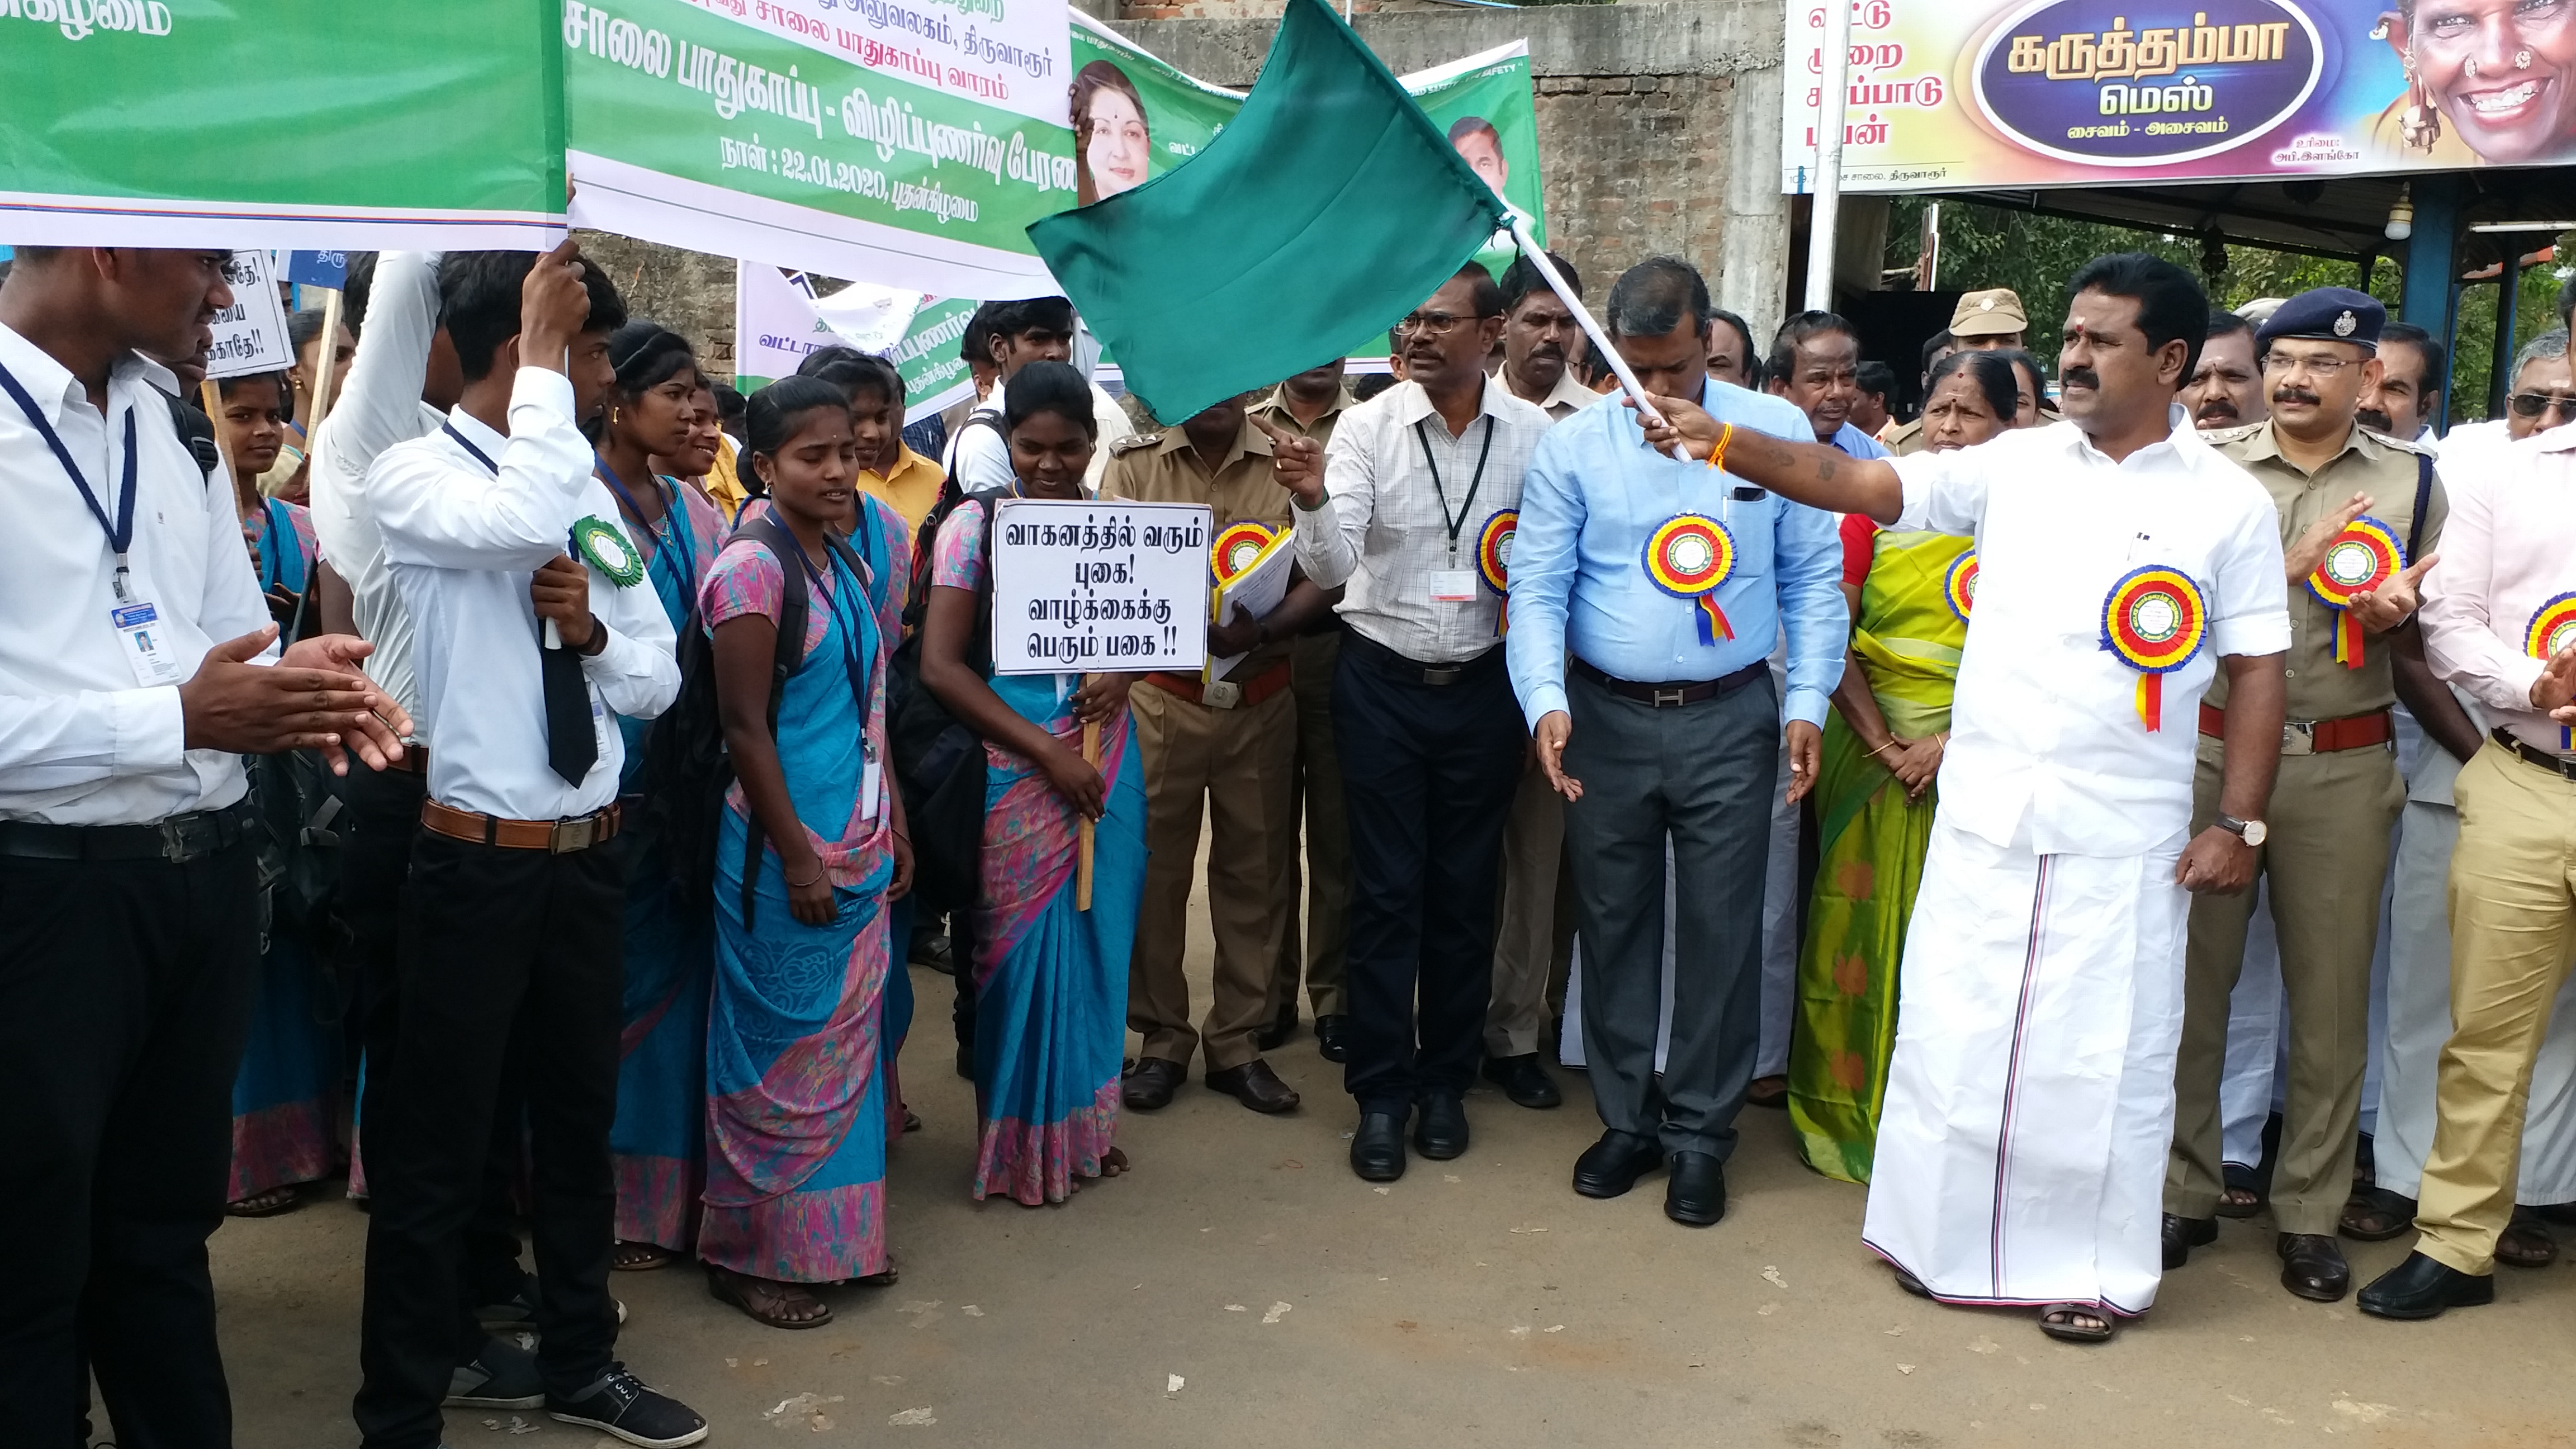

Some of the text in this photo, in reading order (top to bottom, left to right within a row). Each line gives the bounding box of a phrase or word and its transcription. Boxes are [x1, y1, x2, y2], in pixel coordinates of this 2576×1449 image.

[756, 0, 1008, 100] சாலை பாதுகாப்பு வாரம்
[964, 25, 1052, 78] திருவாரூர்
[2007, 12, 2289, 83] கருத்தம்மா
[1481, 63, 1516, 77] SAFETY
[564, 0, 671, 78] சாலை
[678, 40, 823, 139] பாதுகாப்பு
[842, 87, 1005, 185] விழிப்புணர்வு
[2099, 76, 2213, 116] மெஸ்
[2067, 120, 2130, 139] சைவம்
[2144, 116, 2228, 135] அசைவம்
[2296, 137, 2340, 148] உரிமை:
[1889, 167, 1947, 182] திருவாரூர்
[2275, 149, 2360, 162] அபி.இளங்கோ
[720, 132, 767, 171] நாள்
[782, 148, 889, 205] 22.01.2020,
[891, 177, 979, 224] புதன்கிழமை
[1006, 514, 1204, 554] வாகனத்தில் வரும்
[1076, 553, 1135, 590] புகை!
[1029, 588, 1171, 628] வாழ்க்கைக்கு
[1027, 626, 1098, 664] பெரும்
[1106, 635, 1156, 656] பகை
